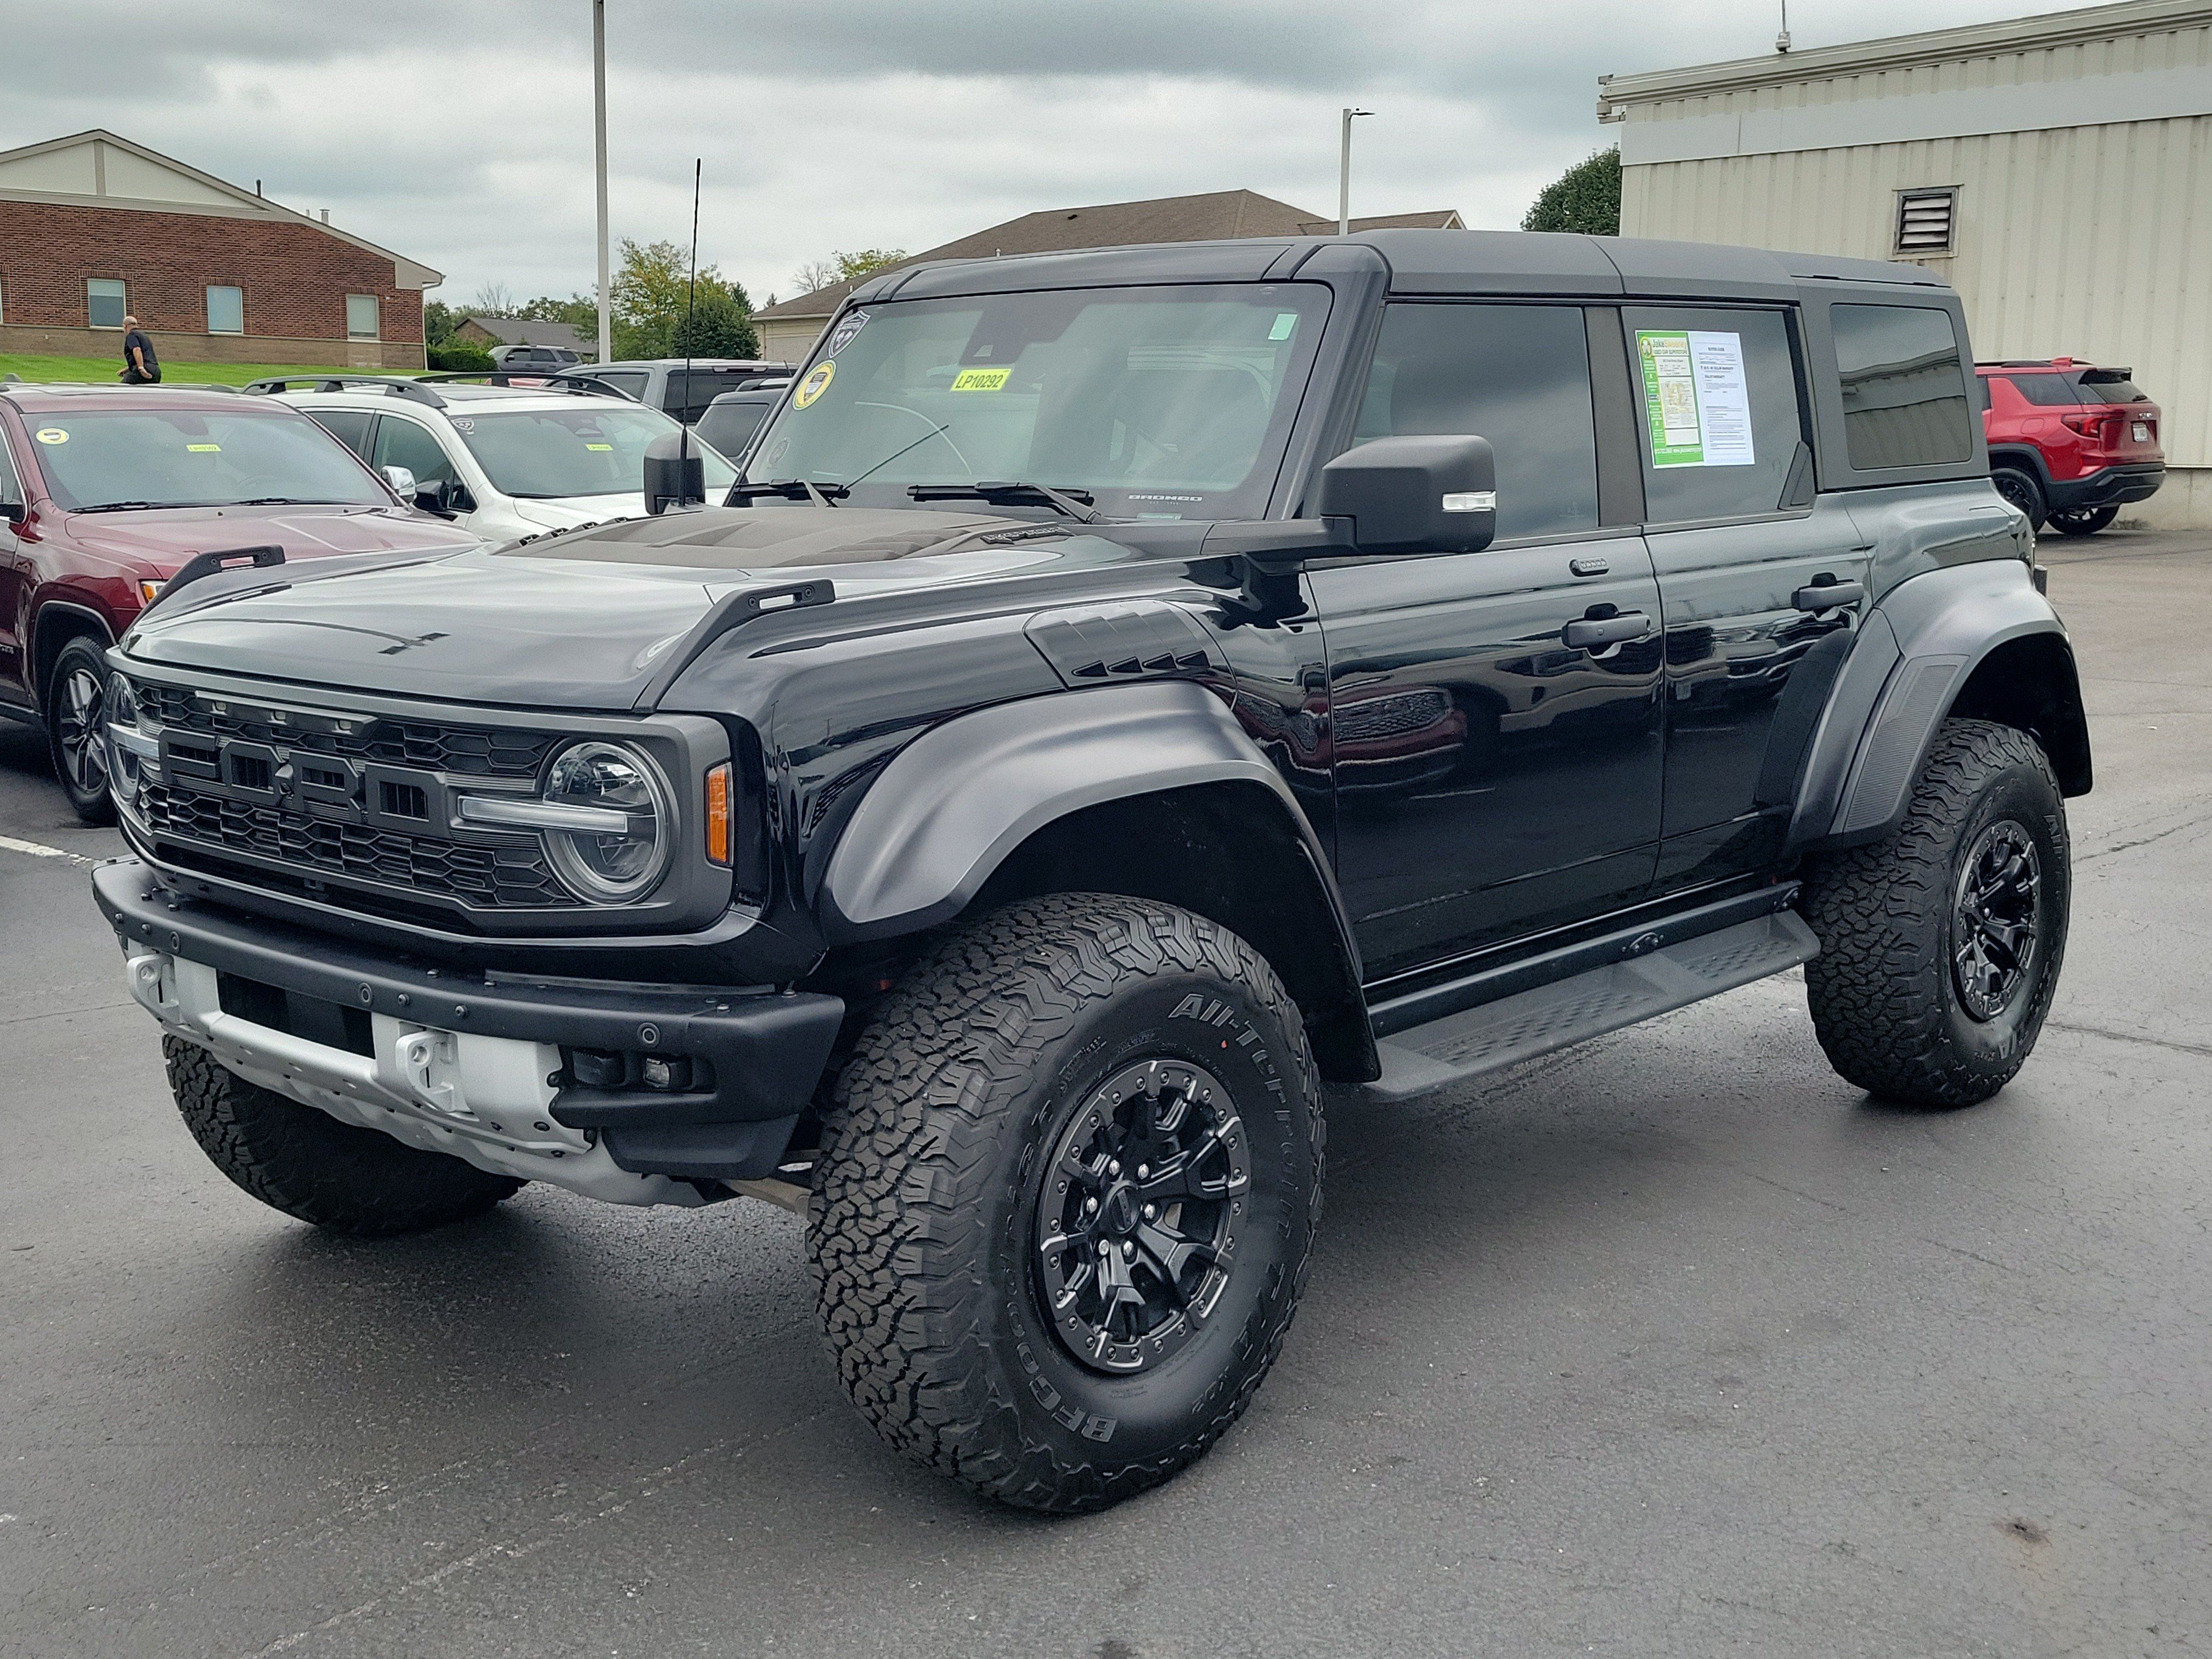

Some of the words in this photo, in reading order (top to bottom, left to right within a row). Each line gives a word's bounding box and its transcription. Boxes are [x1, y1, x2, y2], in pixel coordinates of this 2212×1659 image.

[955, 374, 1003, 388] LP10292
[157, 725, 449, 839] FORD
[1167, 993, 1300, 1240] All-Terrain
